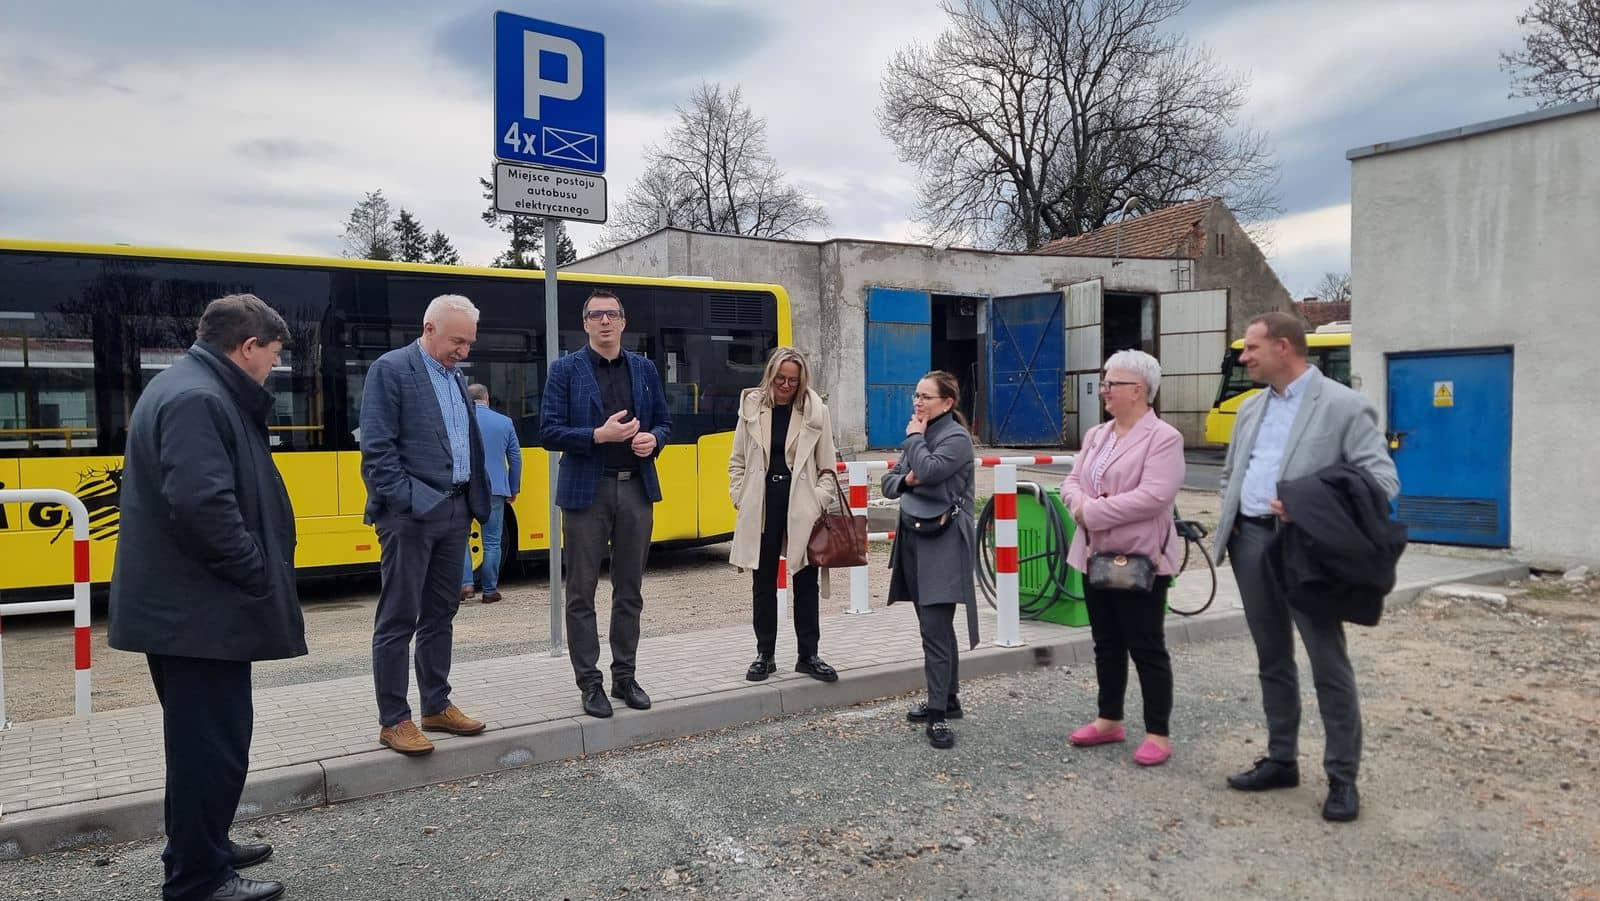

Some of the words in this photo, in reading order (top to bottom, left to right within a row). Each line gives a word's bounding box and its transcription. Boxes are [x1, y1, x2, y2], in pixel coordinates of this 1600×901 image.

[523, 29, 583, 120] P
[503, 121, 537, 156] 4x
[508, 168, 550, 183] Miejsce
[556, 176, 595, 189] postoju
[527, 187, 577, 199] autobusu
[515, 199, 589, 216] elektrycznego
